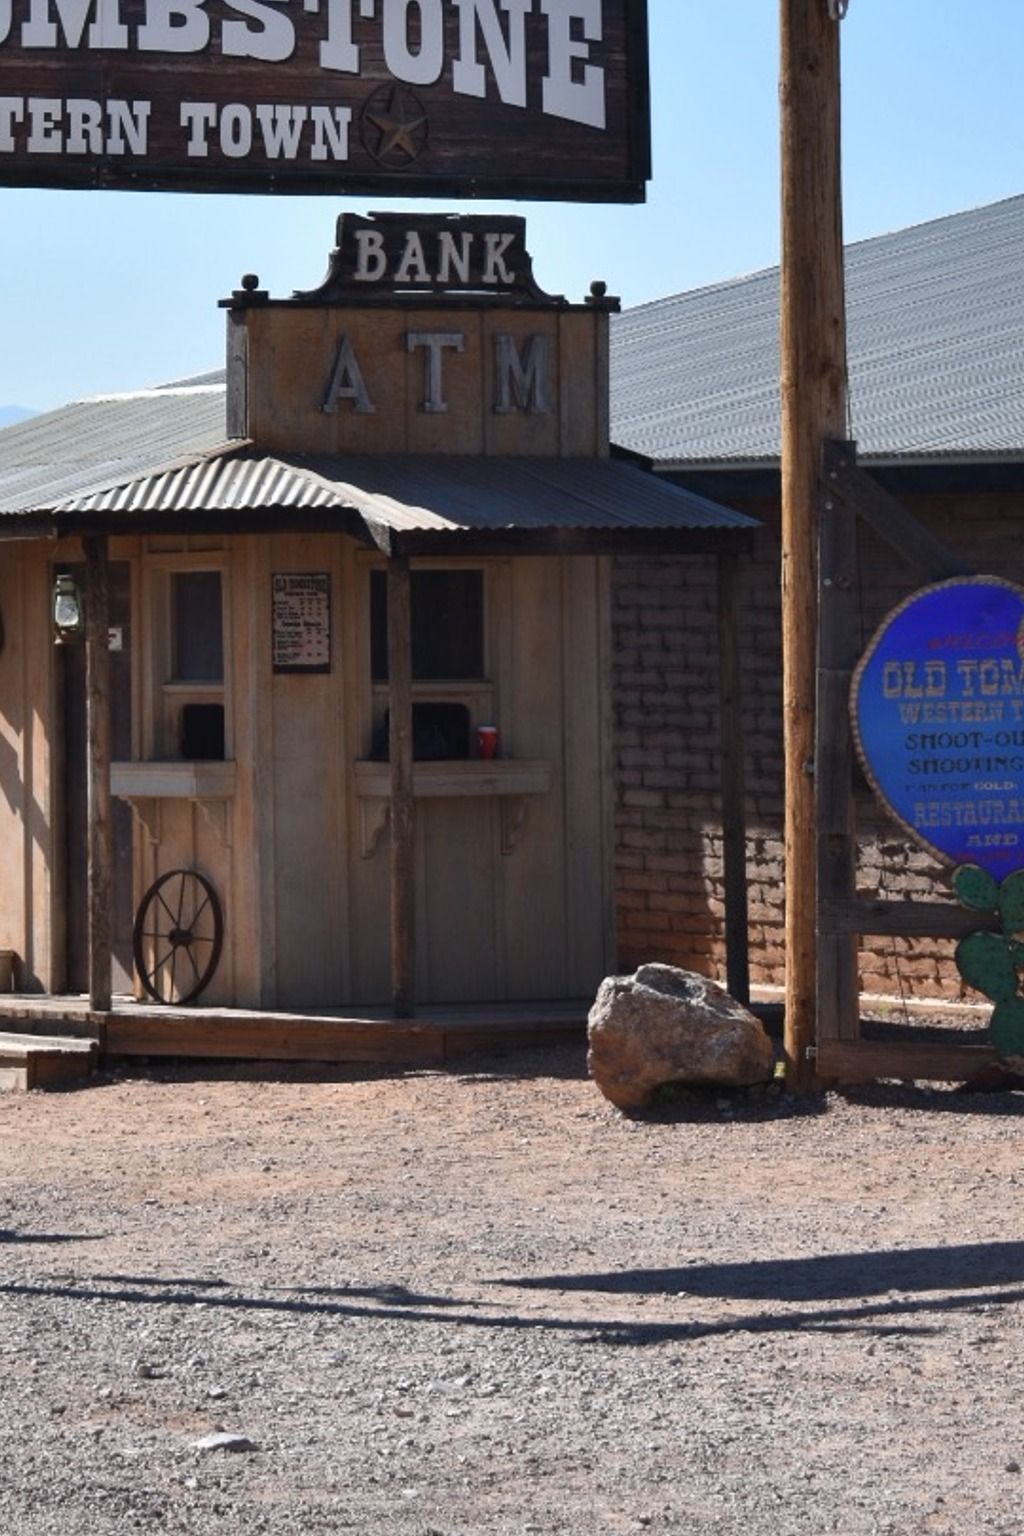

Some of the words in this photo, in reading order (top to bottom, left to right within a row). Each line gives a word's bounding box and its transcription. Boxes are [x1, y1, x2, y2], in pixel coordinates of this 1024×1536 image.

[180, 102, 352, 161] TOWN
[353, 230, 515, 284] BANK
[883, 661, 946, 698] OLD
[899, 701, 1004, 724] WESTERN
